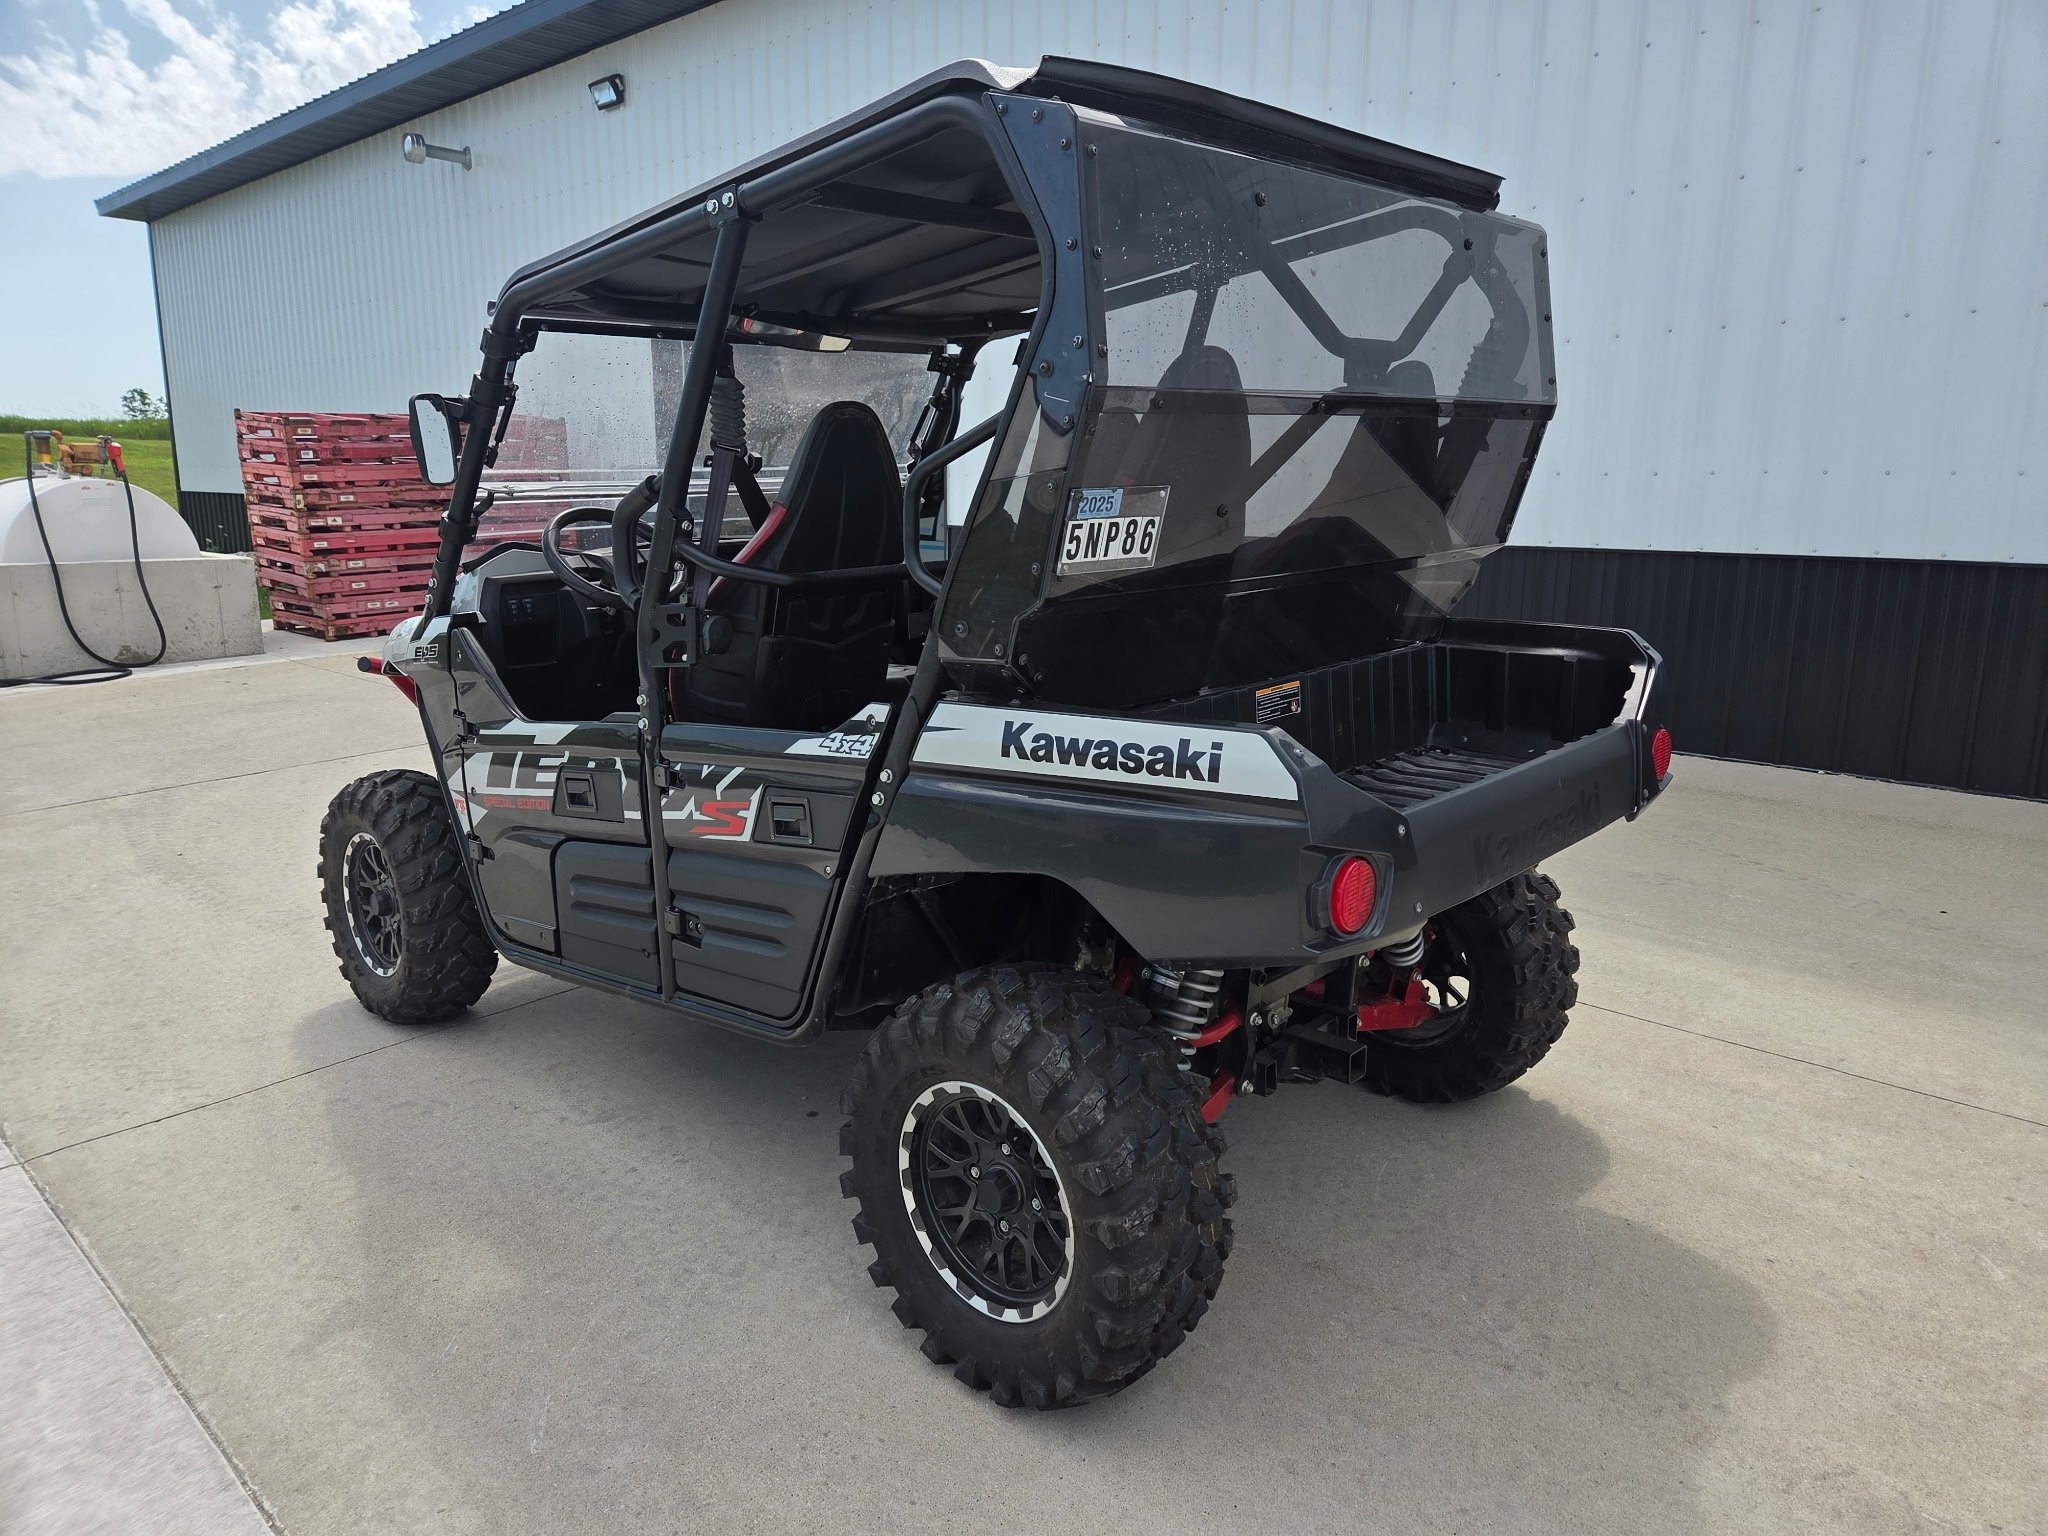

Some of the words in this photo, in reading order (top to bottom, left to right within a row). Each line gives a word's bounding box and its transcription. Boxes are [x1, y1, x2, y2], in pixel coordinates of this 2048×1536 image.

[1080, 495, 1115, 514] 2025
[1065, 519, 1156, 560] 5NP86
[818, 732, 875, 756] 4x4
[1001, 720, 1224, 783] Kawasaki
[483, 796, 515, 808] SPECIAL
[517, 797, 550, 810] EDITION
